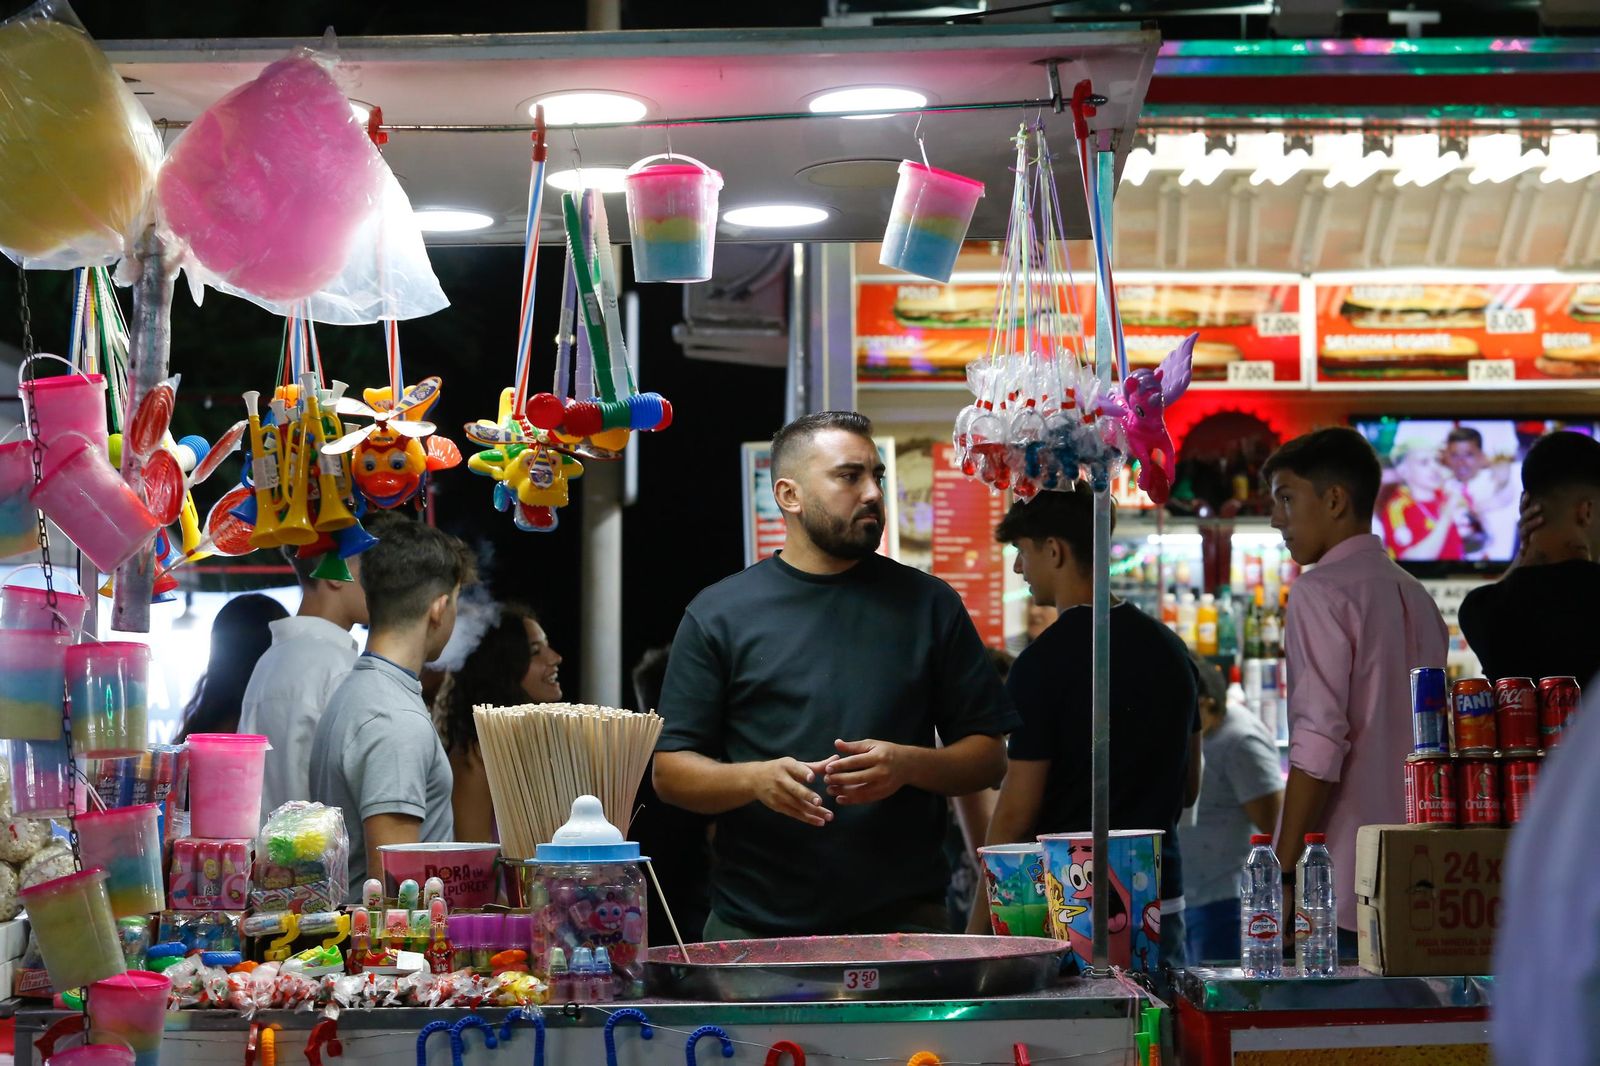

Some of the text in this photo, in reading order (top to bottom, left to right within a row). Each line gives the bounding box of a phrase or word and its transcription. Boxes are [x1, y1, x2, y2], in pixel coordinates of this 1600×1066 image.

[1455, 691, 1493, 712] FANT
[1418, 799, 1457, 810] Cruzca
[1465, 799, 1499, 810] Cruzca
[1443, 851, 1481, 884] 24
[1438, 888, 1504, 930] 50c
